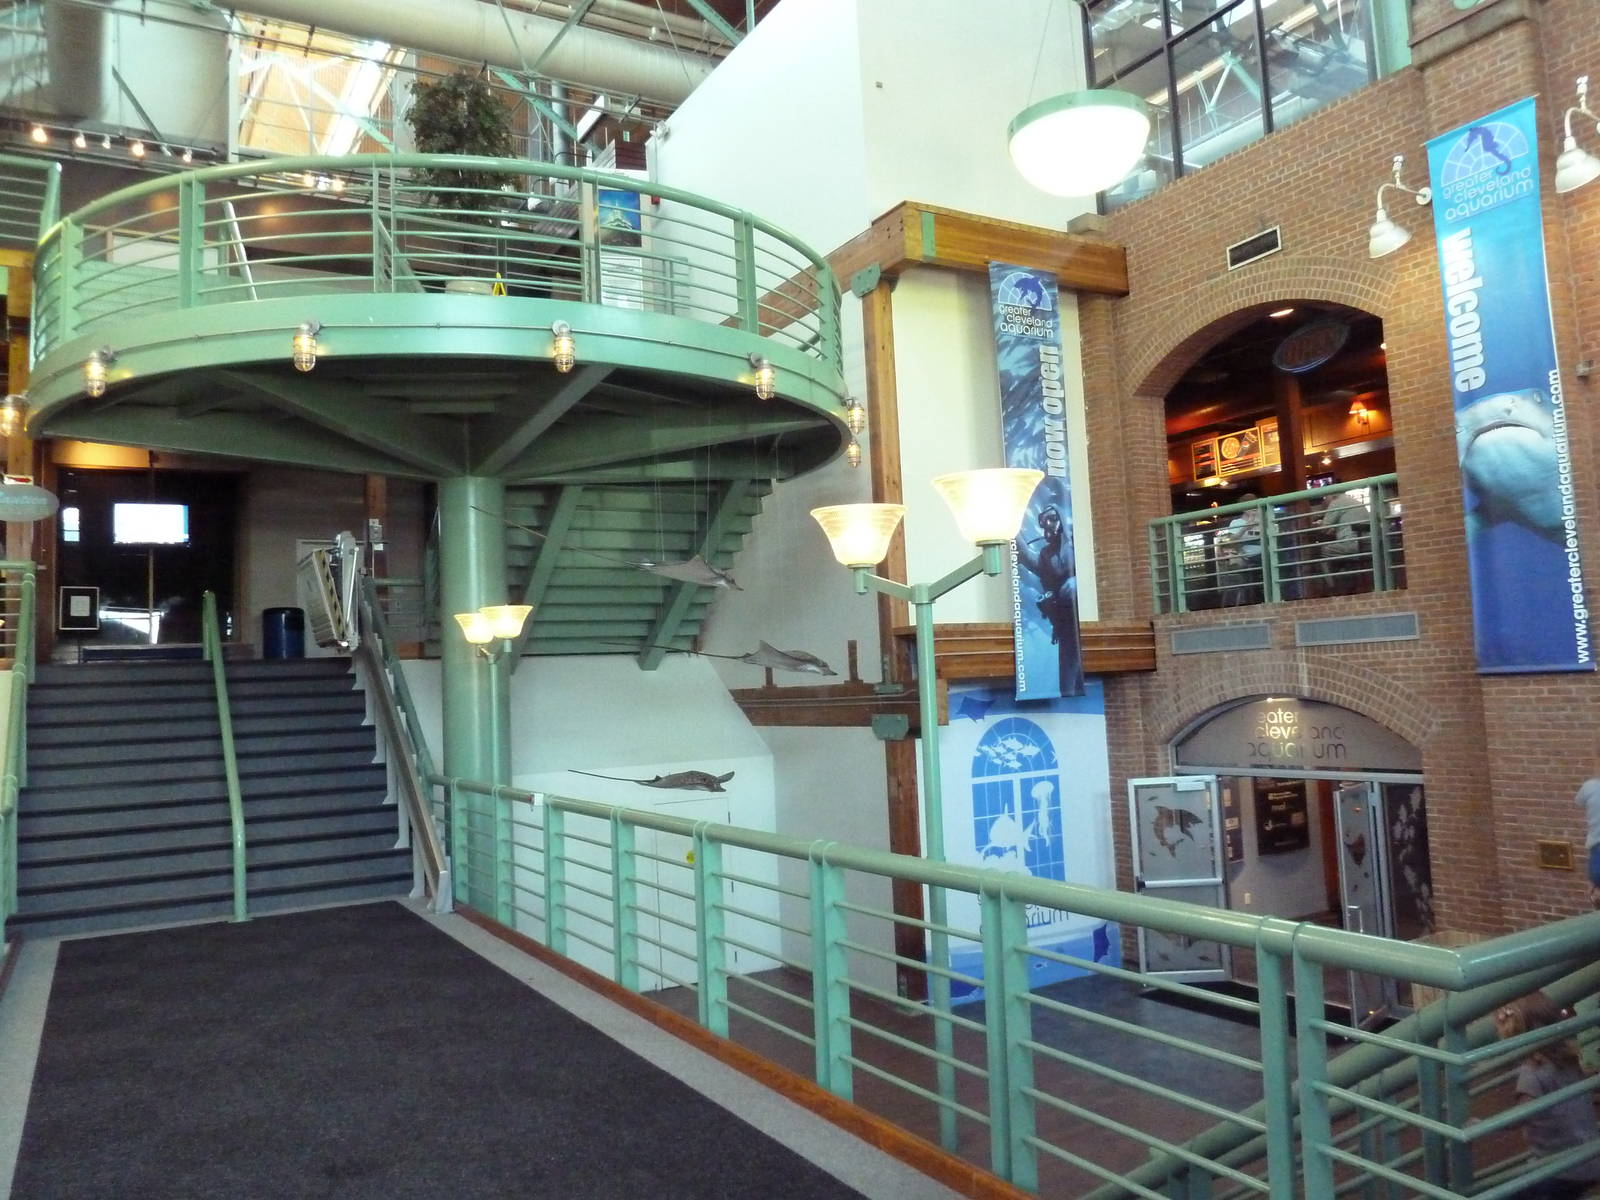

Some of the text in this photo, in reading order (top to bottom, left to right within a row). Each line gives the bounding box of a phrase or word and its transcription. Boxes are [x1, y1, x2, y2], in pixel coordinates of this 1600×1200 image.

[1443, 169, 1492, 199] greater
[1455, 167, 1531, 204] cleveland
[1445, 179, 1534, 220] aquarium
[999, 304, 1031, 316] greater
[1006, 313, 1053, 329] cleveland
[1441, 226, 1487, 393] welcome
[1000, 322, 1054, 338] aquarium
[1039, 344, 1067, 477] now open
[1548, 368, 1590, 664] www.greaterclevelandaquarium.com
[1010, 537, 1027, 692] rclevelandaquarium.com
[1256, 707, 1299, 724] eater
[1254, 722, 1345, 740] cleveand
[1247, 741, 1346, 762] aquarum
